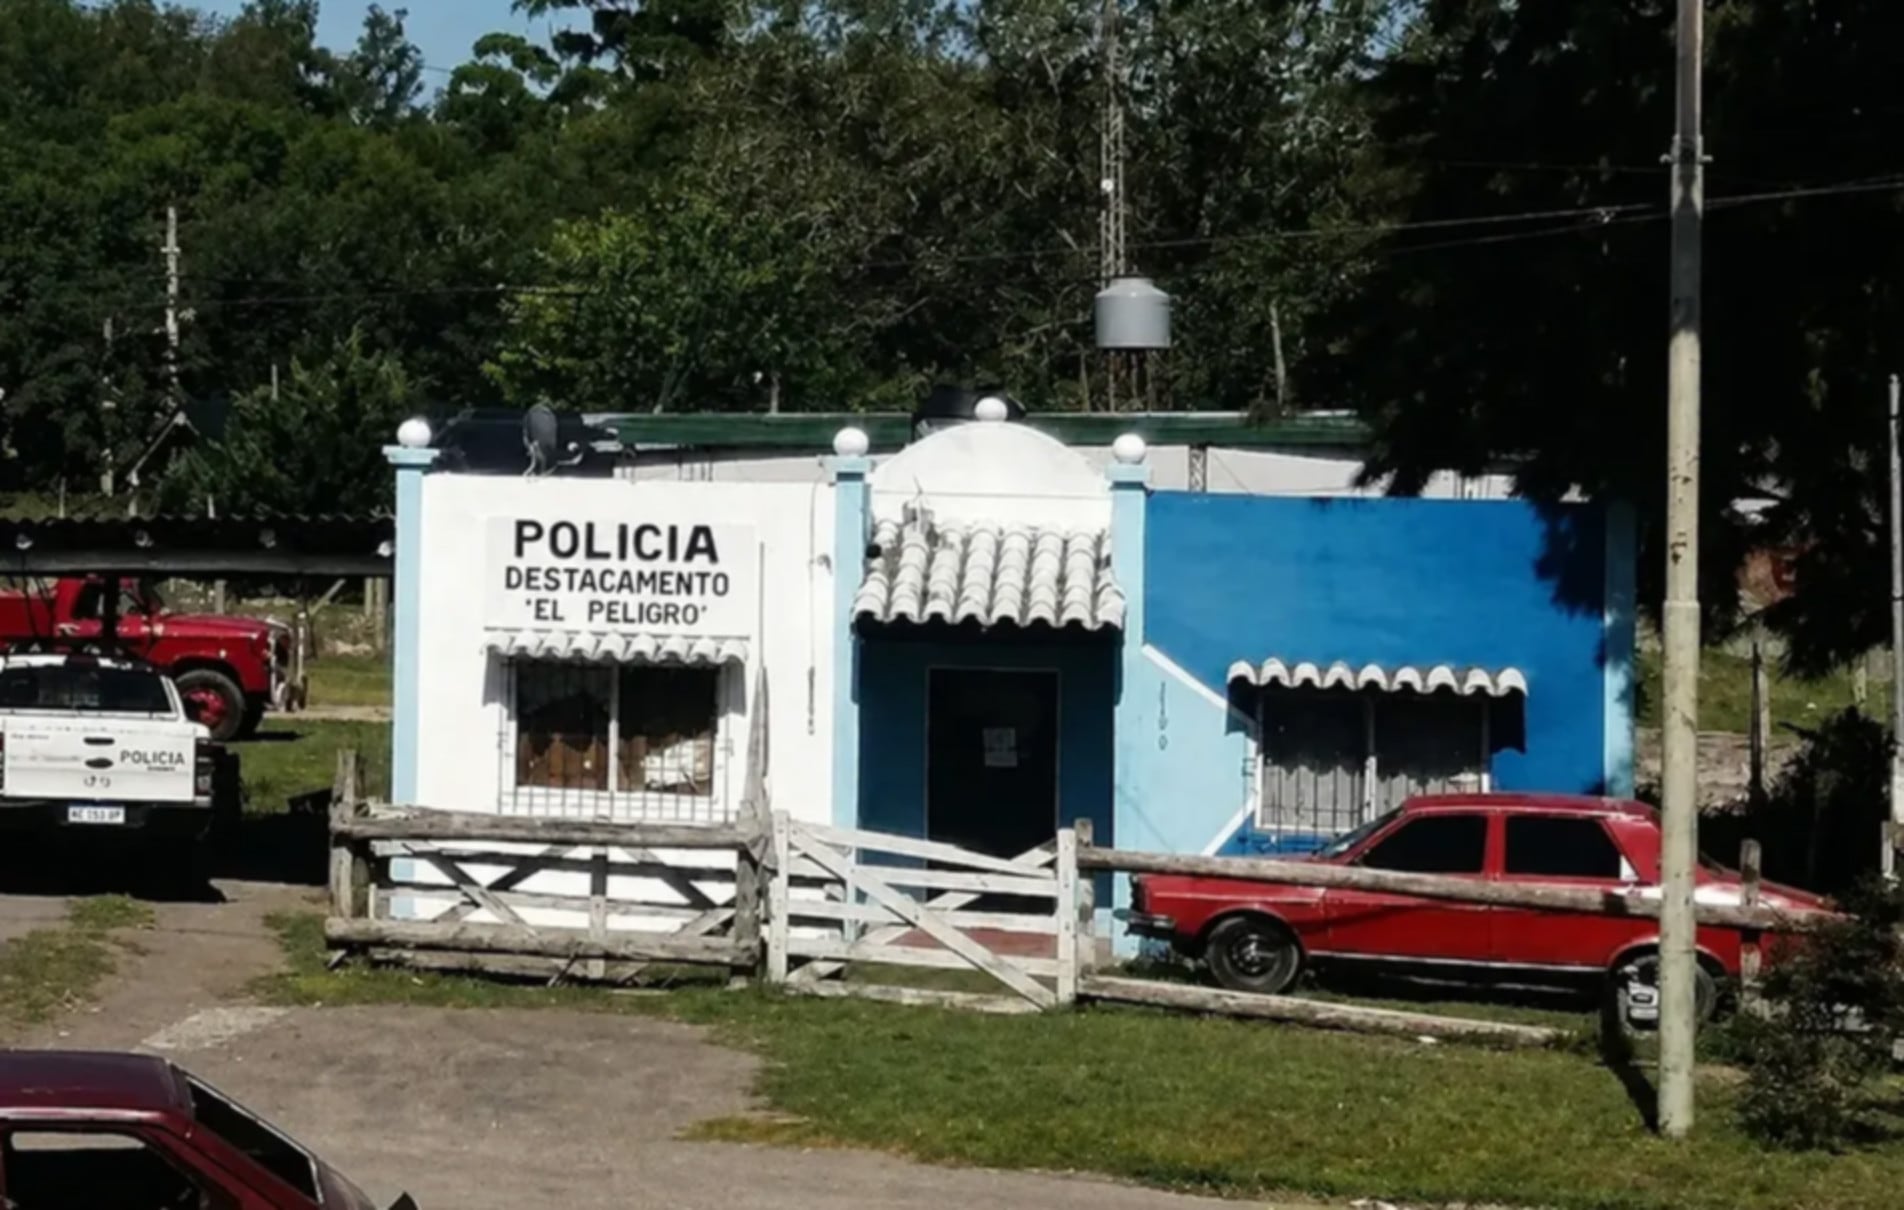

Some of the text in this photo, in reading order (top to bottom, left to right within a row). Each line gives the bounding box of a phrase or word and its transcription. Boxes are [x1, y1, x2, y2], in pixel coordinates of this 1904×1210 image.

[514, 519, 719, 564] POLICIA
[504, 566, 729, 597] DESTACAMENTO
[120, 750, 185, 765] POLICIA
